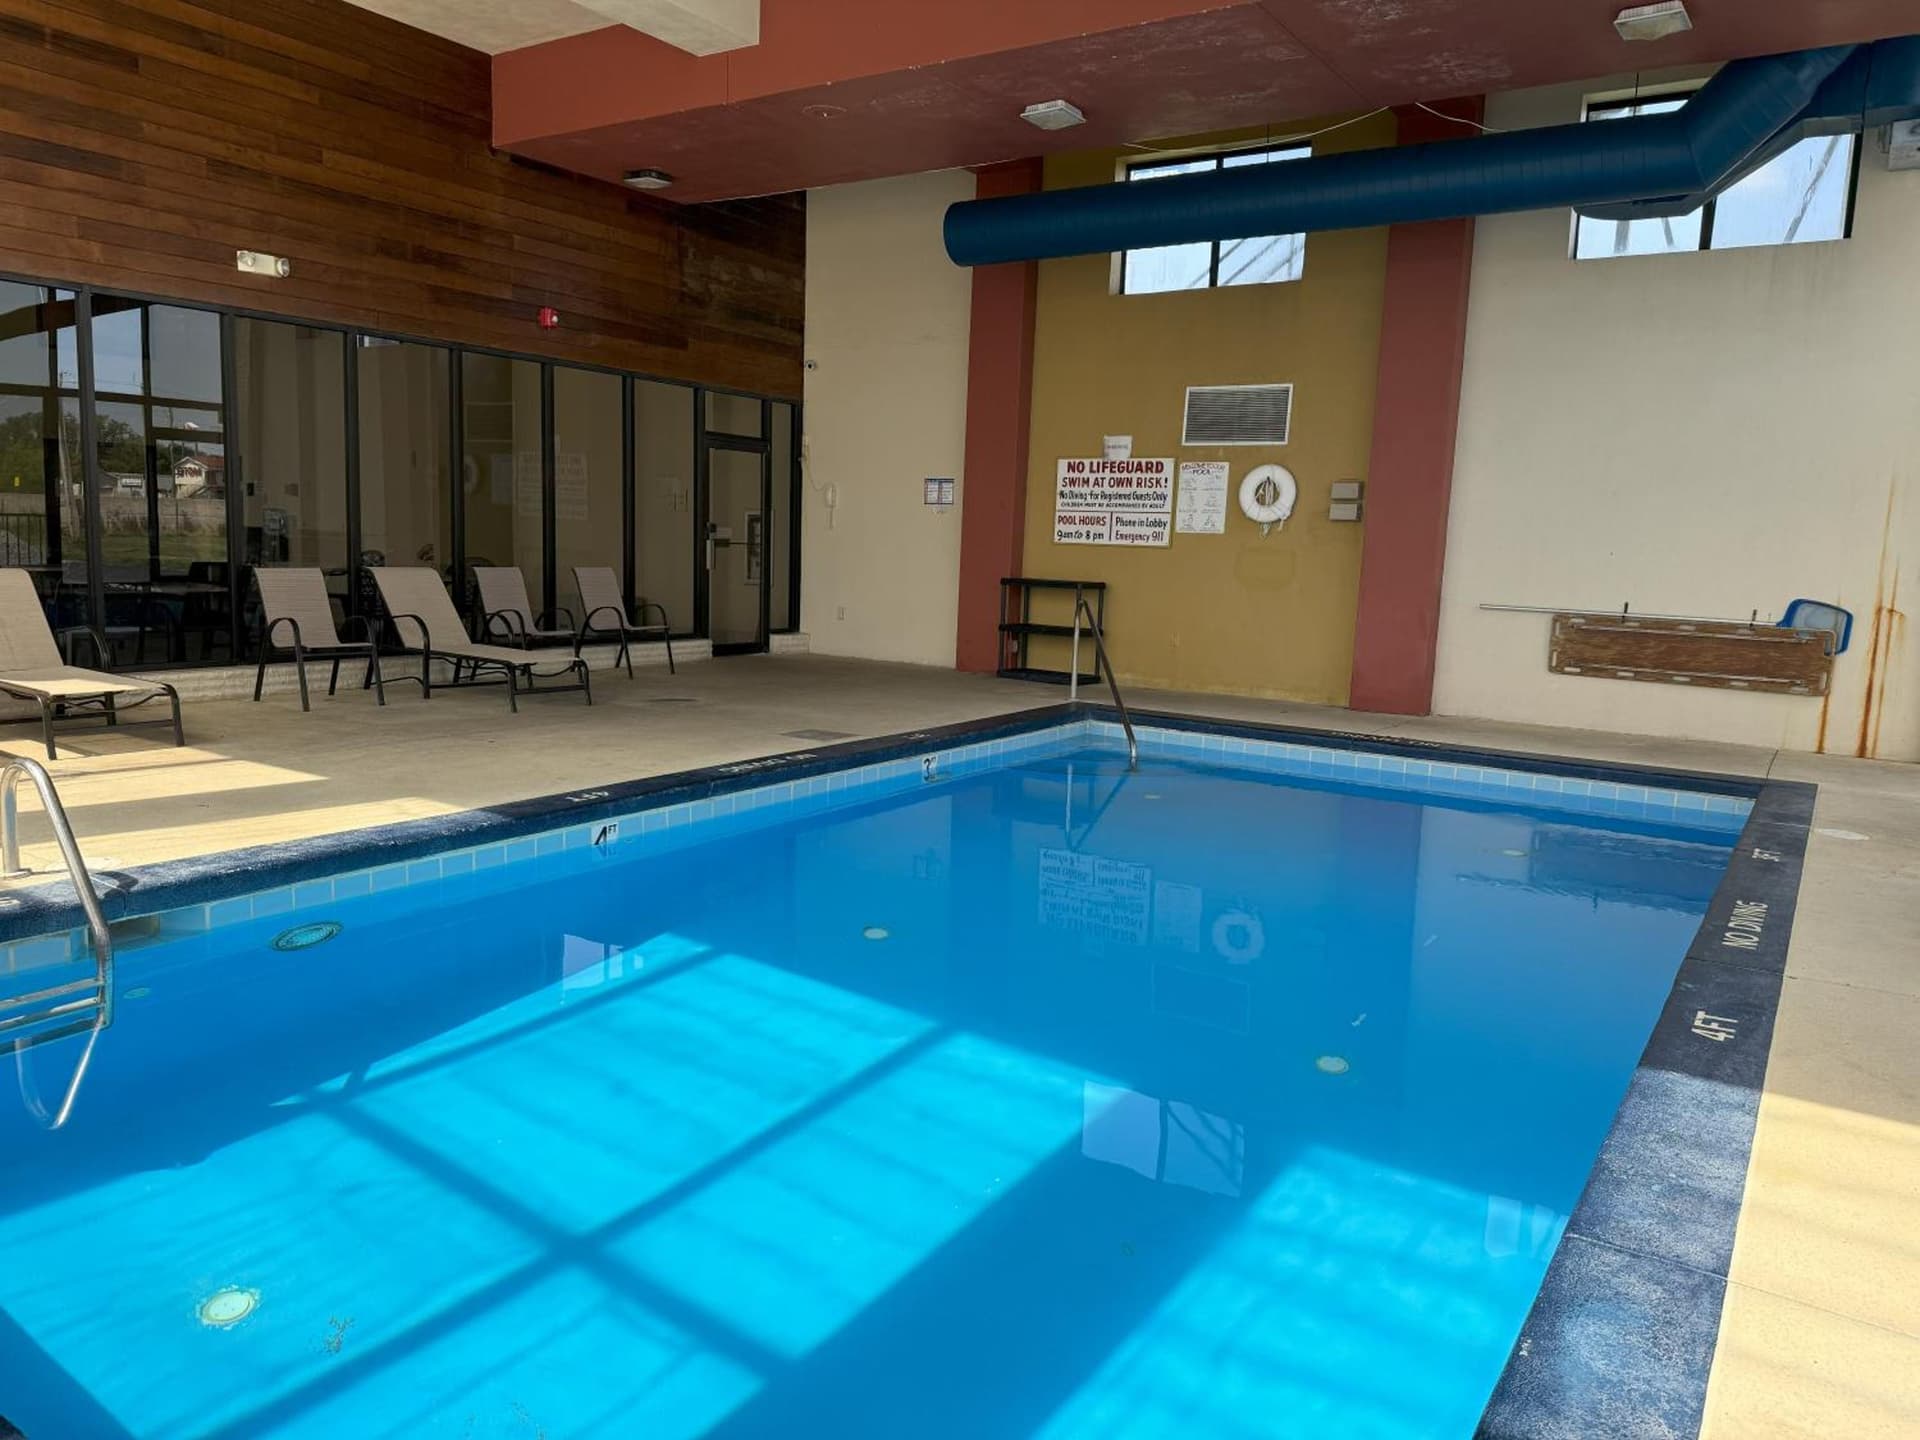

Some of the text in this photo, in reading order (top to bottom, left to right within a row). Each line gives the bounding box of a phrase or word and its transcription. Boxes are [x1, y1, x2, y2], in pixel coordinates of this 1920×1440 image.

[1067, 461, 1164, 474] NO LIFEGUARD
[1062, 477, 1090, 488] SWIM
[1092, 477, 1106, 488] AT
[1108, 477, 1133, 488] OWN
[1058, 515, 1107, 527] POOL HOURS
[1115, 516, 1168, 530] Phone in Lobby
[1085, 530, 1091, 541] 8
[1093, 533, 1104, 542] pm
[1115, 530, 1164, 543] Emergency 911
[1721, 900, 1769, 950] NO DIVING
[1691, 1010, 1739, 1042] 4FT
